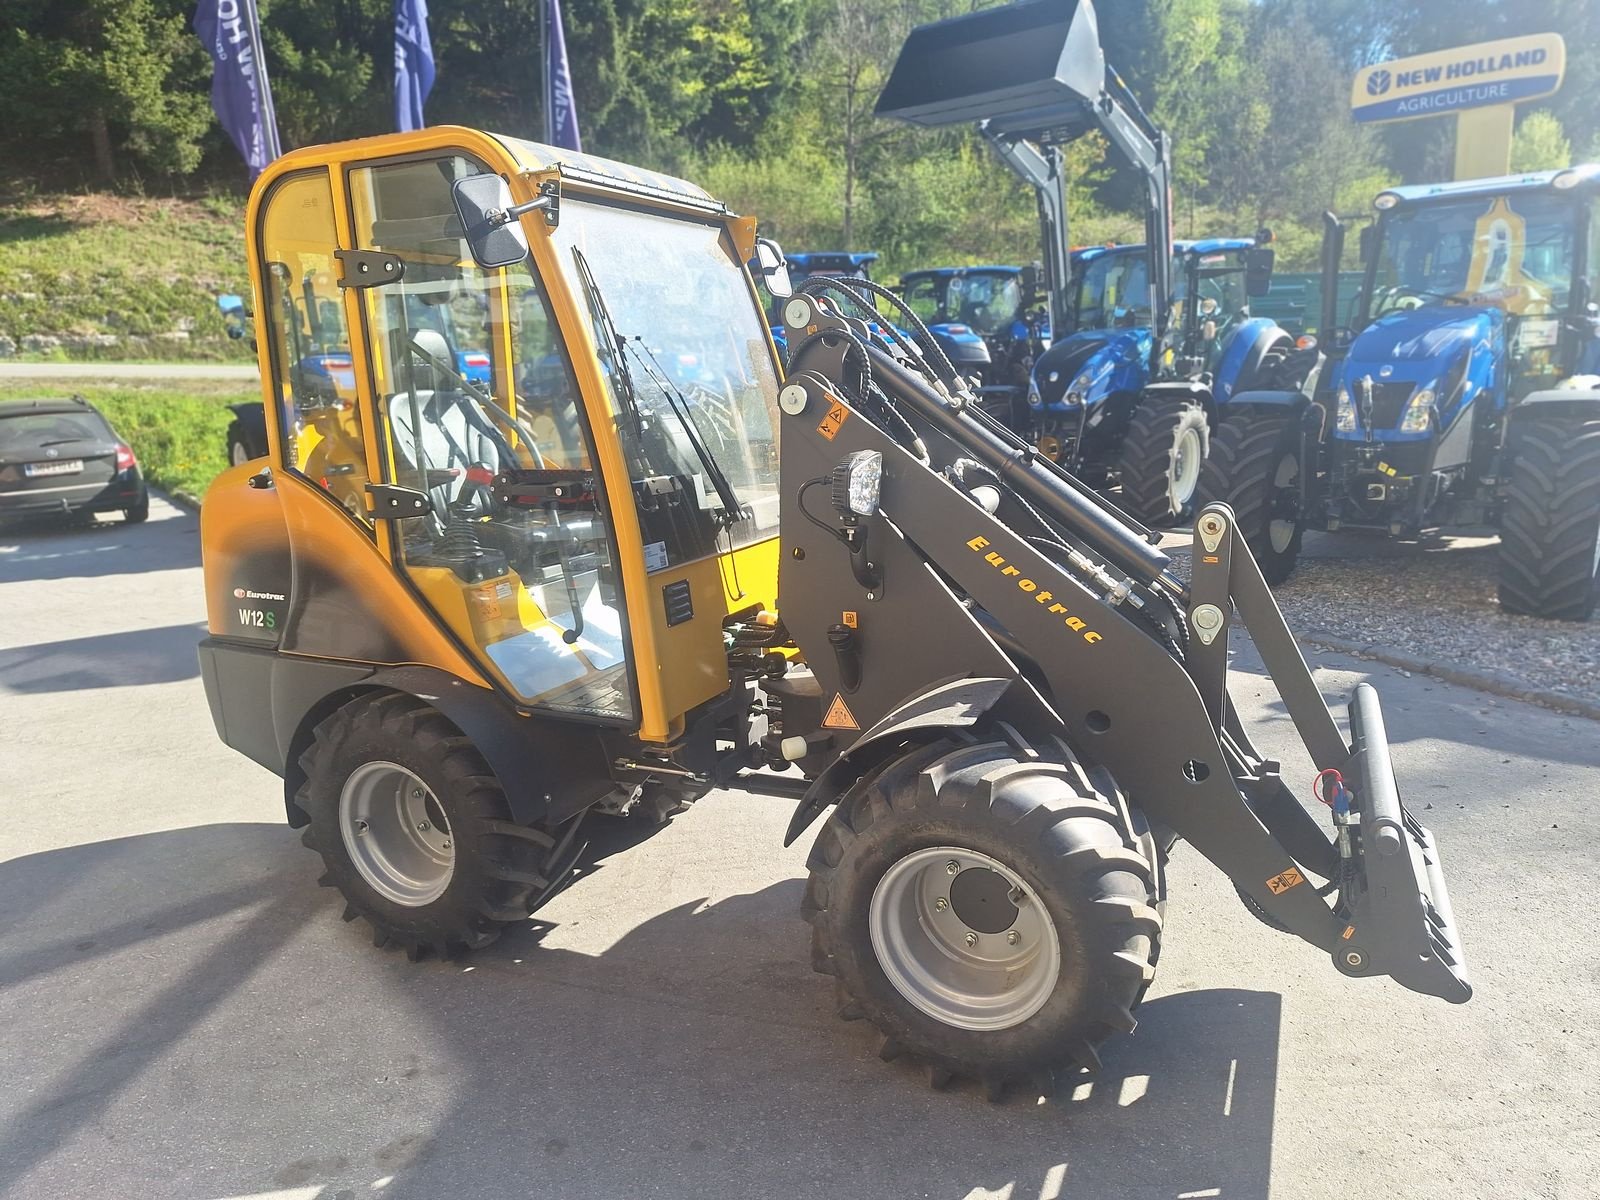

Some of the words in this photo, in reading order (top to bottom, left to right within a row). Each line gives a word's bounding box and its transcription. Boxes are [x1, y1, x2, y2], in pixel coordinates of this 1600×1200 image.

[1396, 65, 1443, 88] NEW
[1446, 48, 1546, 80] HOLLAND
[1396, 82, 1509, 113] AGRICULTURE
[246, 590, 285, 600] Eurotrac
[966, 535, 1103, 644] Eurotrac
